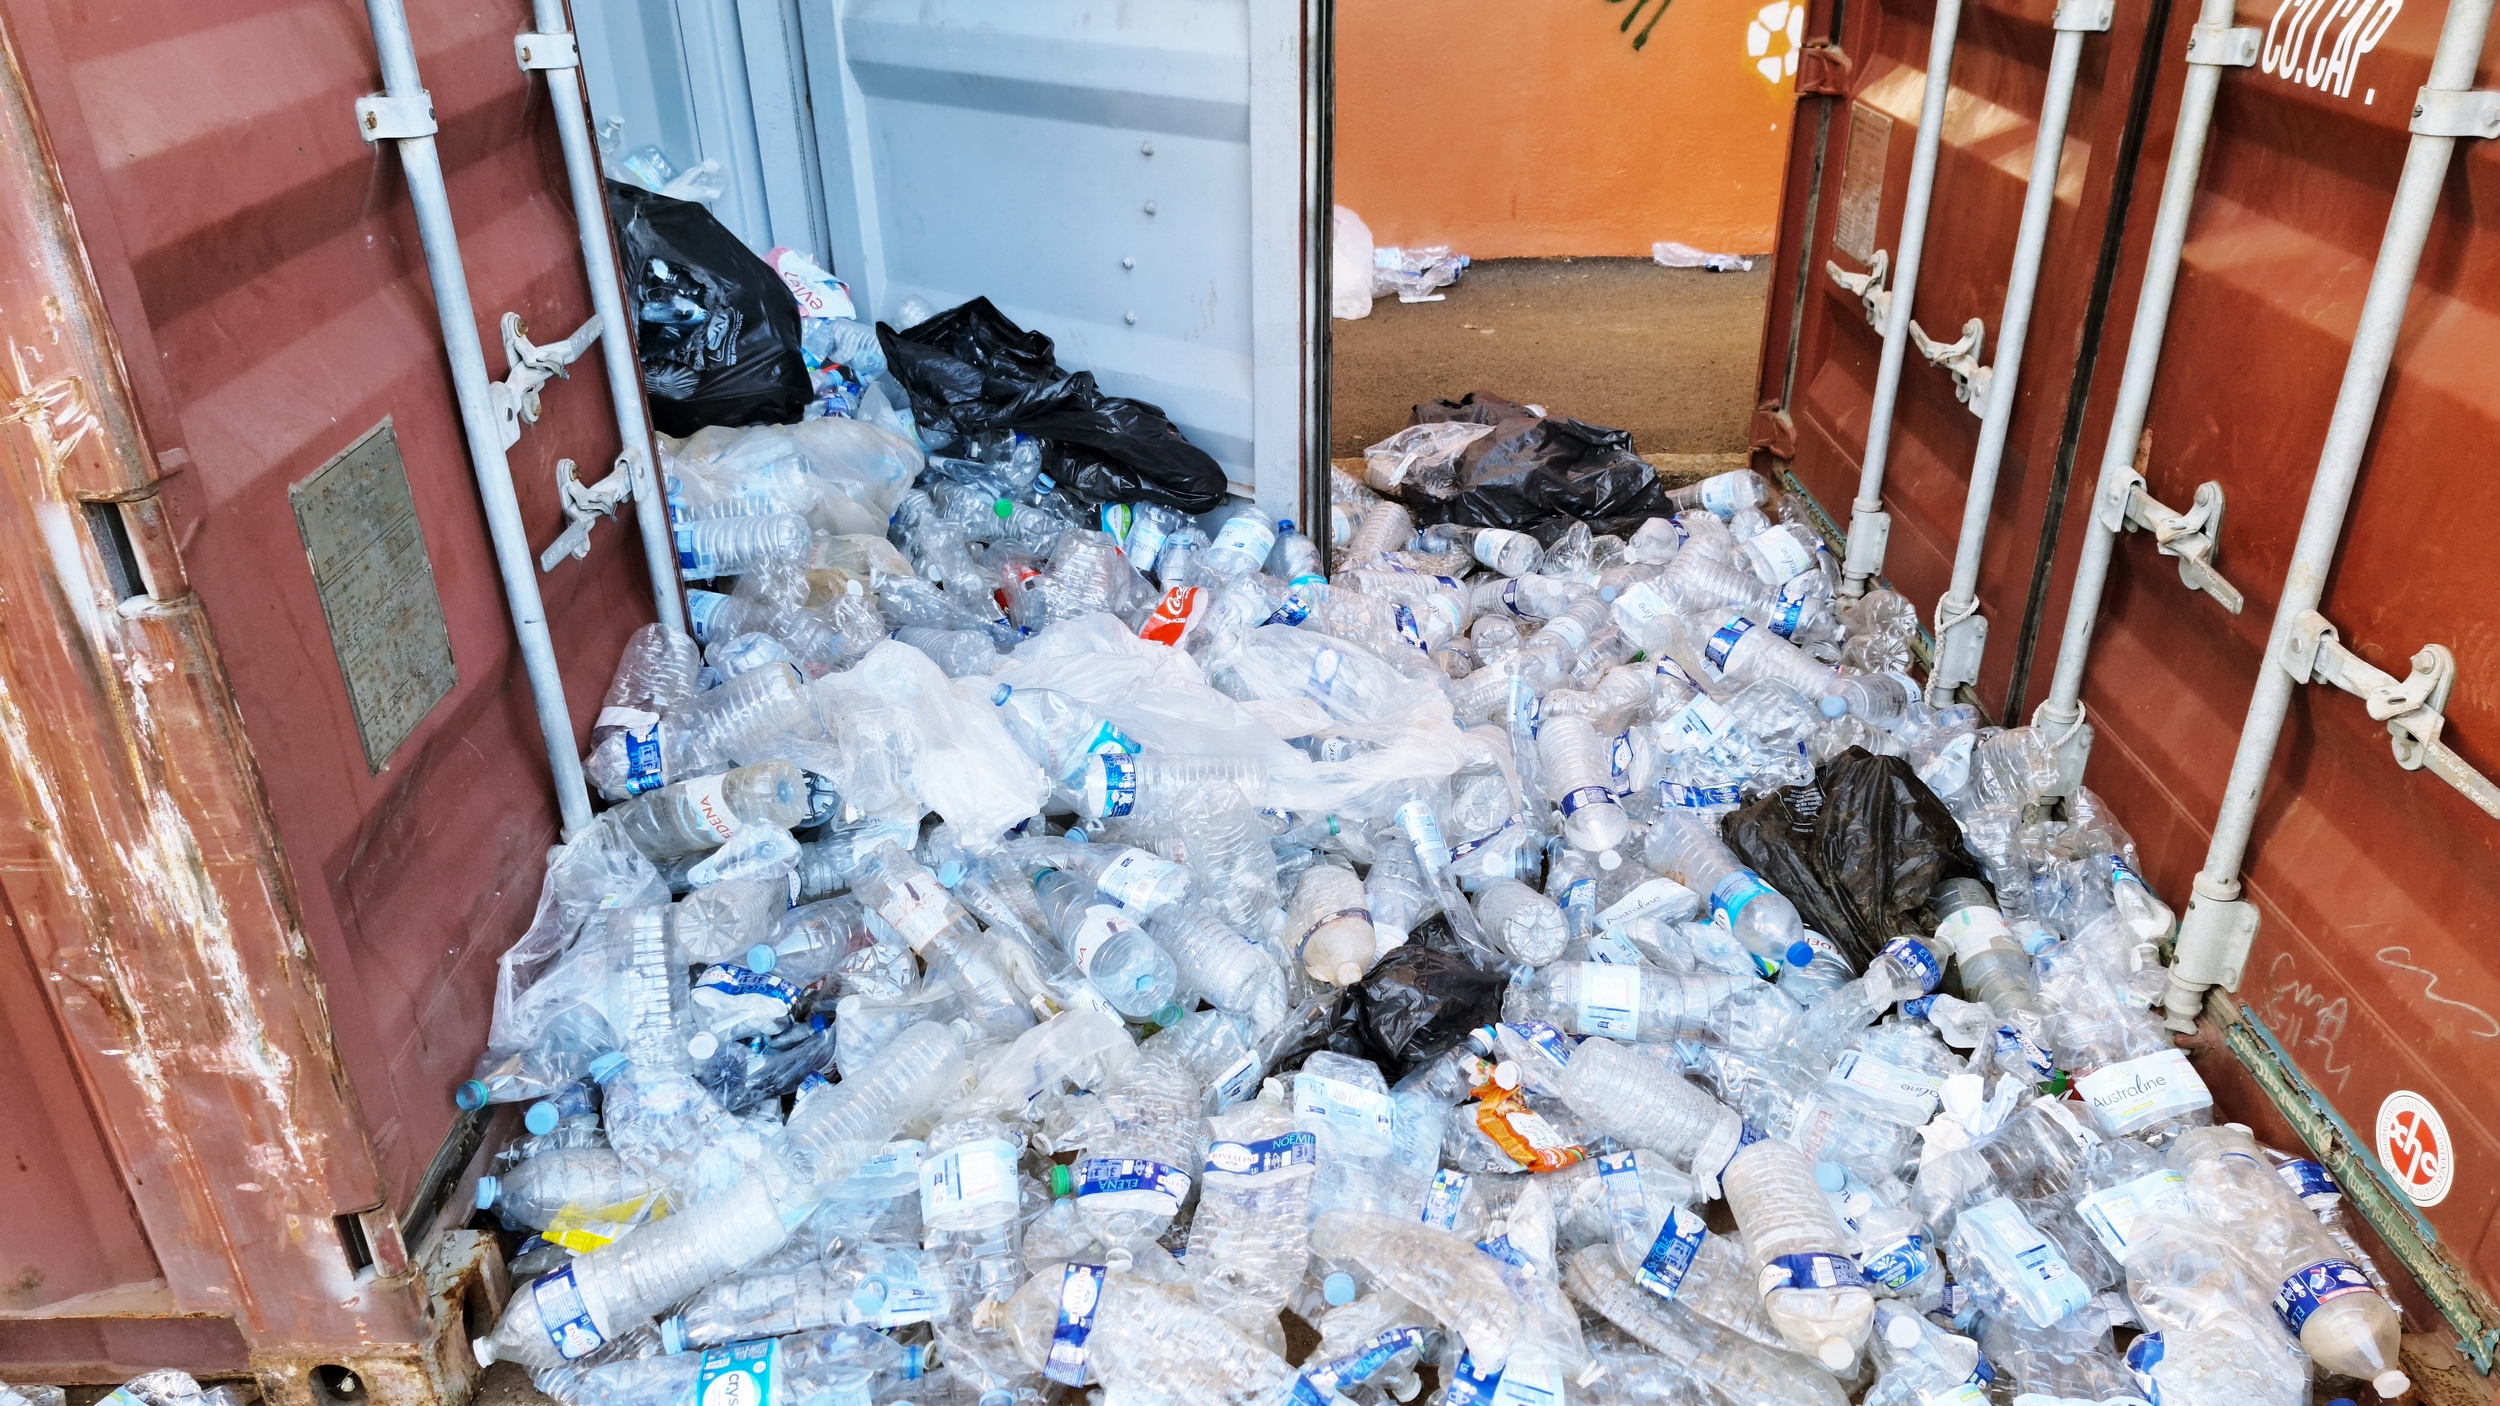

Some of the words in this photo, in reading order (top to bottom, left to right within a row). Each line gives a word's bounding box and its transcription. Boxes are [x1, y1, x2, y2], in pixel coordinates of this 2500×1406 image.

[1606, 896, 1662, 926] Australine
[1901, 1083, 1940, 1098] aline
[2093, 1073, 2167, 1110] Australine
[1099, 1178, 1139, 1191] ELENA
[1678, 1215, 1691, 1237] CRIST
[725, 1373, 740, 1406] crys
